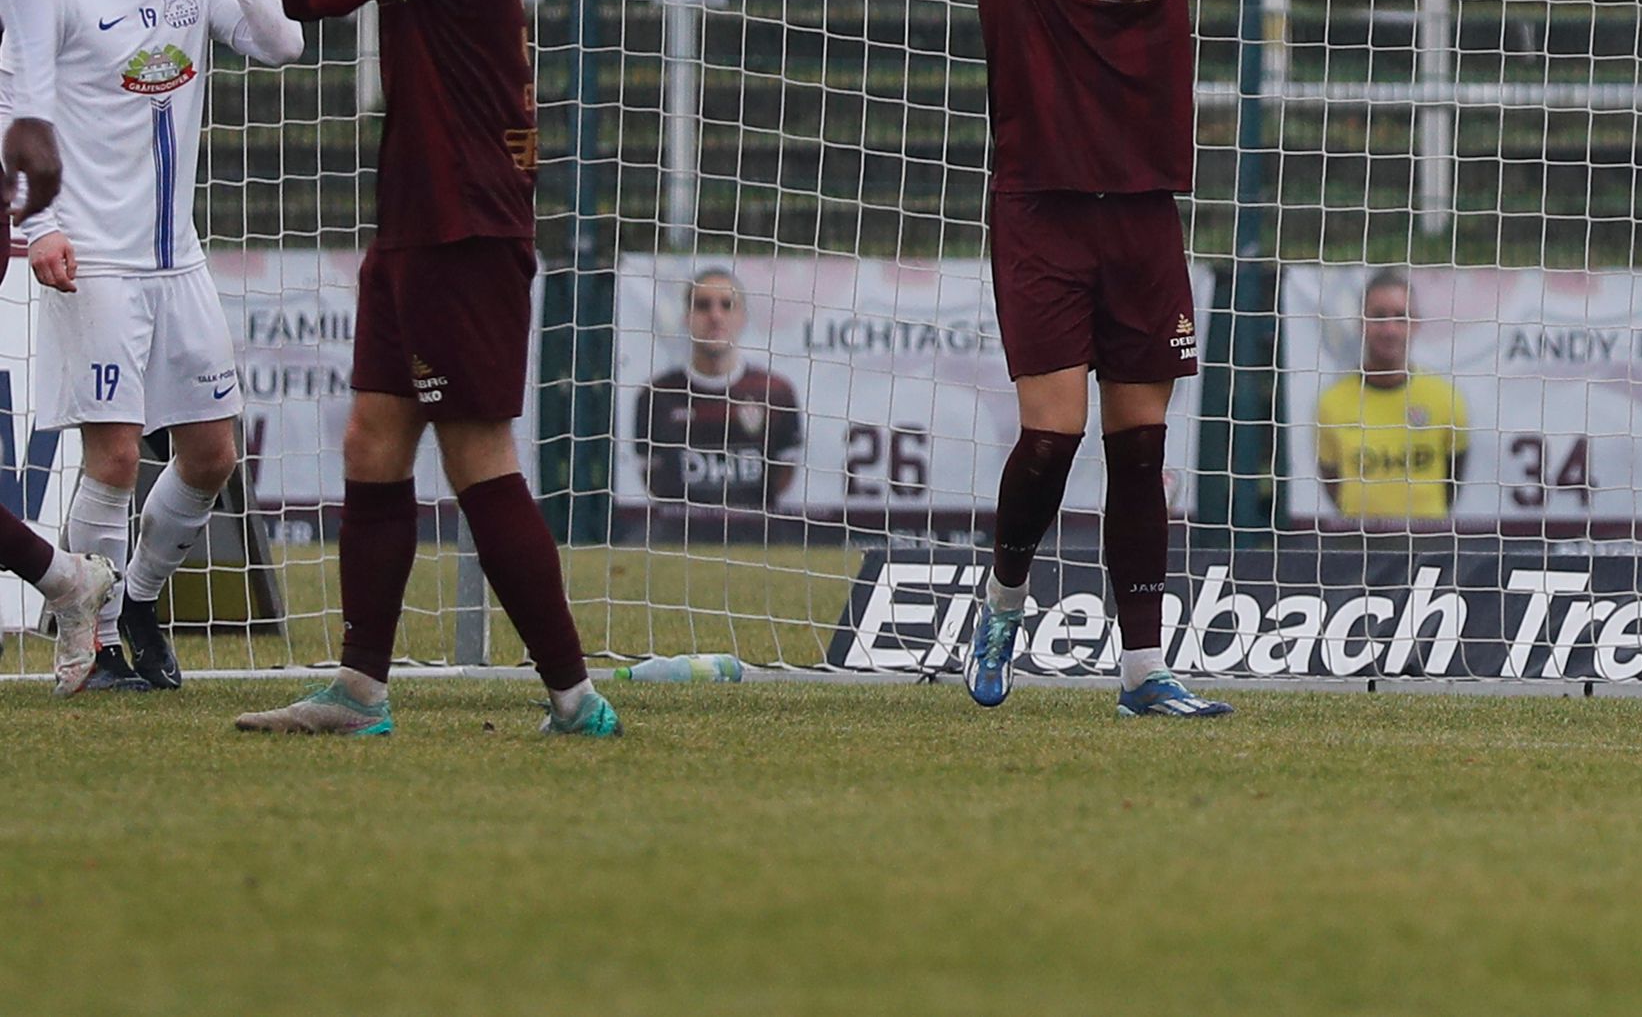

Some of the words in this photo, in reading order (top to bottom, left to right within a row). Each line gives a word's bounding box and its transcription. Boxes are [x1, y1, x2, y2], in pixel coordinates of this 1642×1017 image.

[138, 7, 158, 29] 19
[1506, 328, 1614, 361] ANDY
[90, 363, 120, 401] 19
[844, 423, 928, 498] 26
[1510, 436, 1598, 508] 34
[1129, 582, 1165, 593] JAKO
[844, 563, 1468, 675] Eienbach
